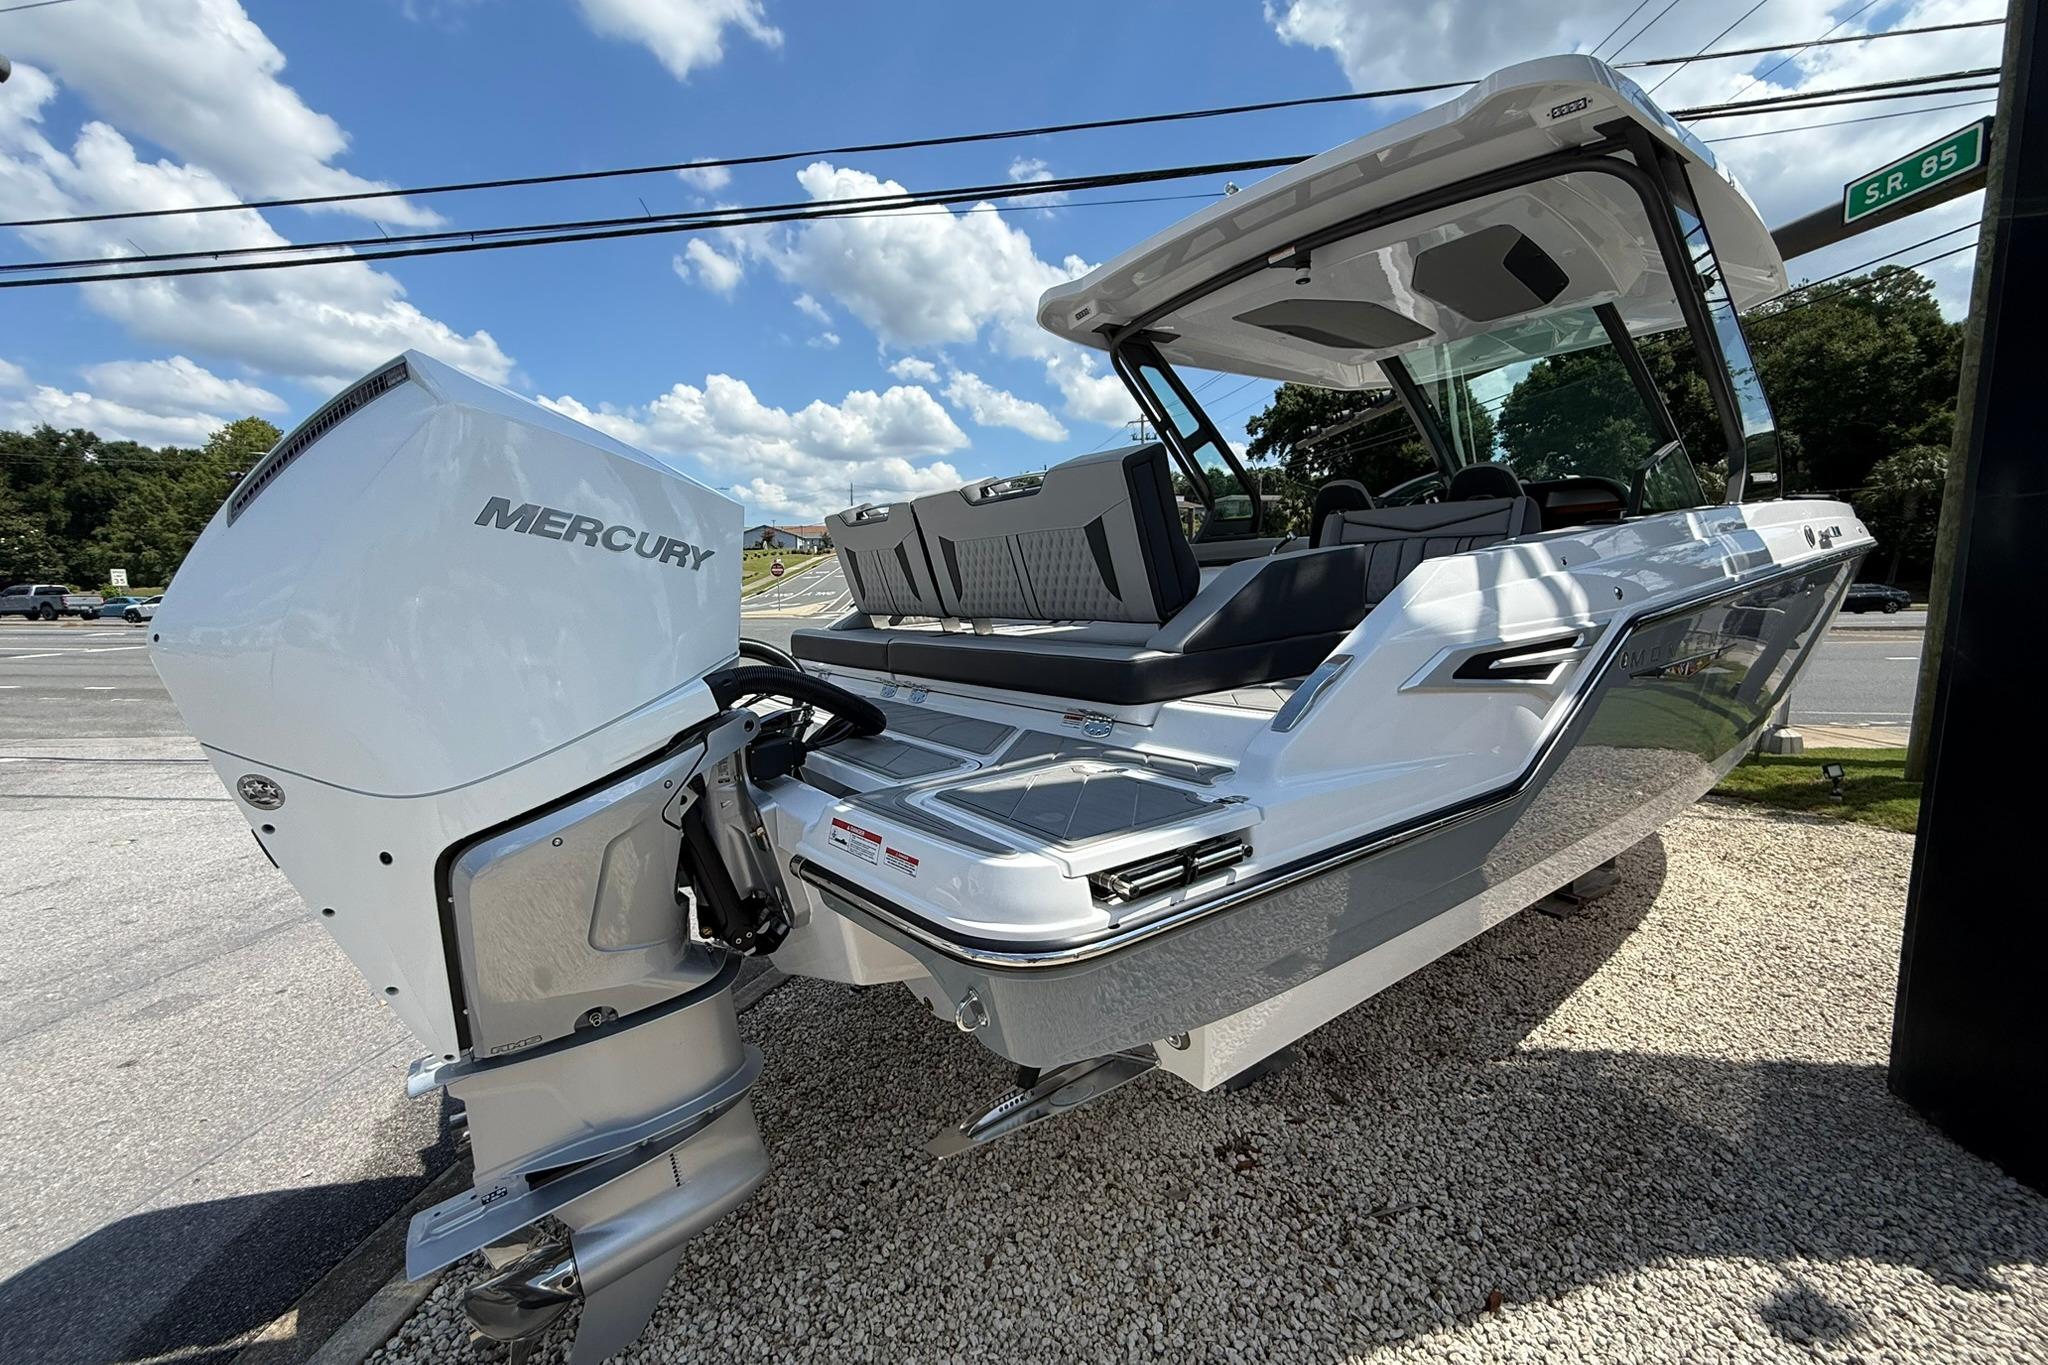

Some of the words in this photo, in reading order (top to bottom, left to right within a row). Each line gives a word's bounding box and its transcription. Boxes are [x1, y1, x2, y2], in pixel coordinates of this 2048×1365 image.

[1864, 171, 1908, 205] S.R.
[1920, 145, 1958, 179] 85
[474, 496, 716, 571] MERCURY
